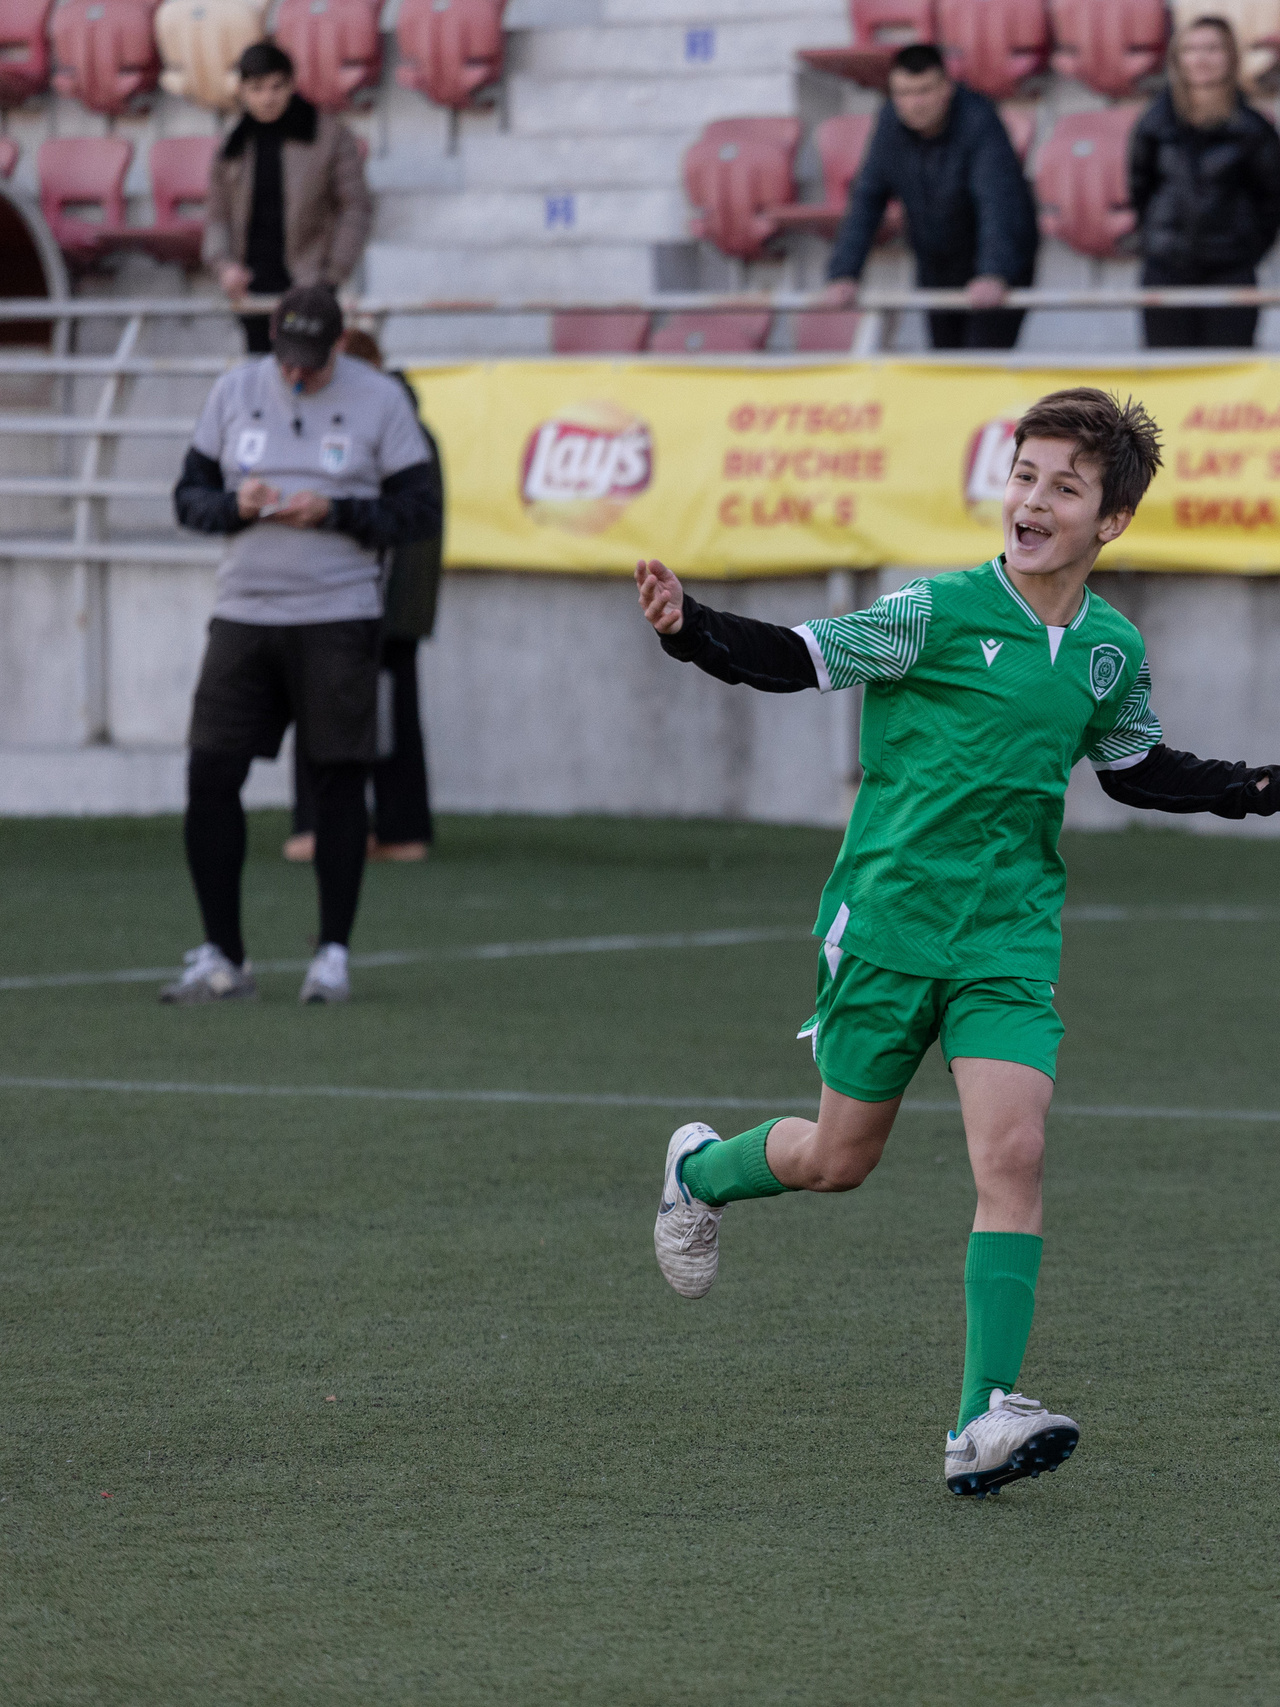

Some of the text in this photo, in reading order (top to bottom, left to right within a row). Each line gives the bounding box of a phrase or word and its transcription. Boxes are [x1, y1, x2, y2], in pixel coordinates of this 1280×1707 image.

[729, 404, 880, 432] ФУТБОЛ
[523, 421, 651, 501] Lay's
[724, 448, 886, 480] ВКУСНЕЕ
